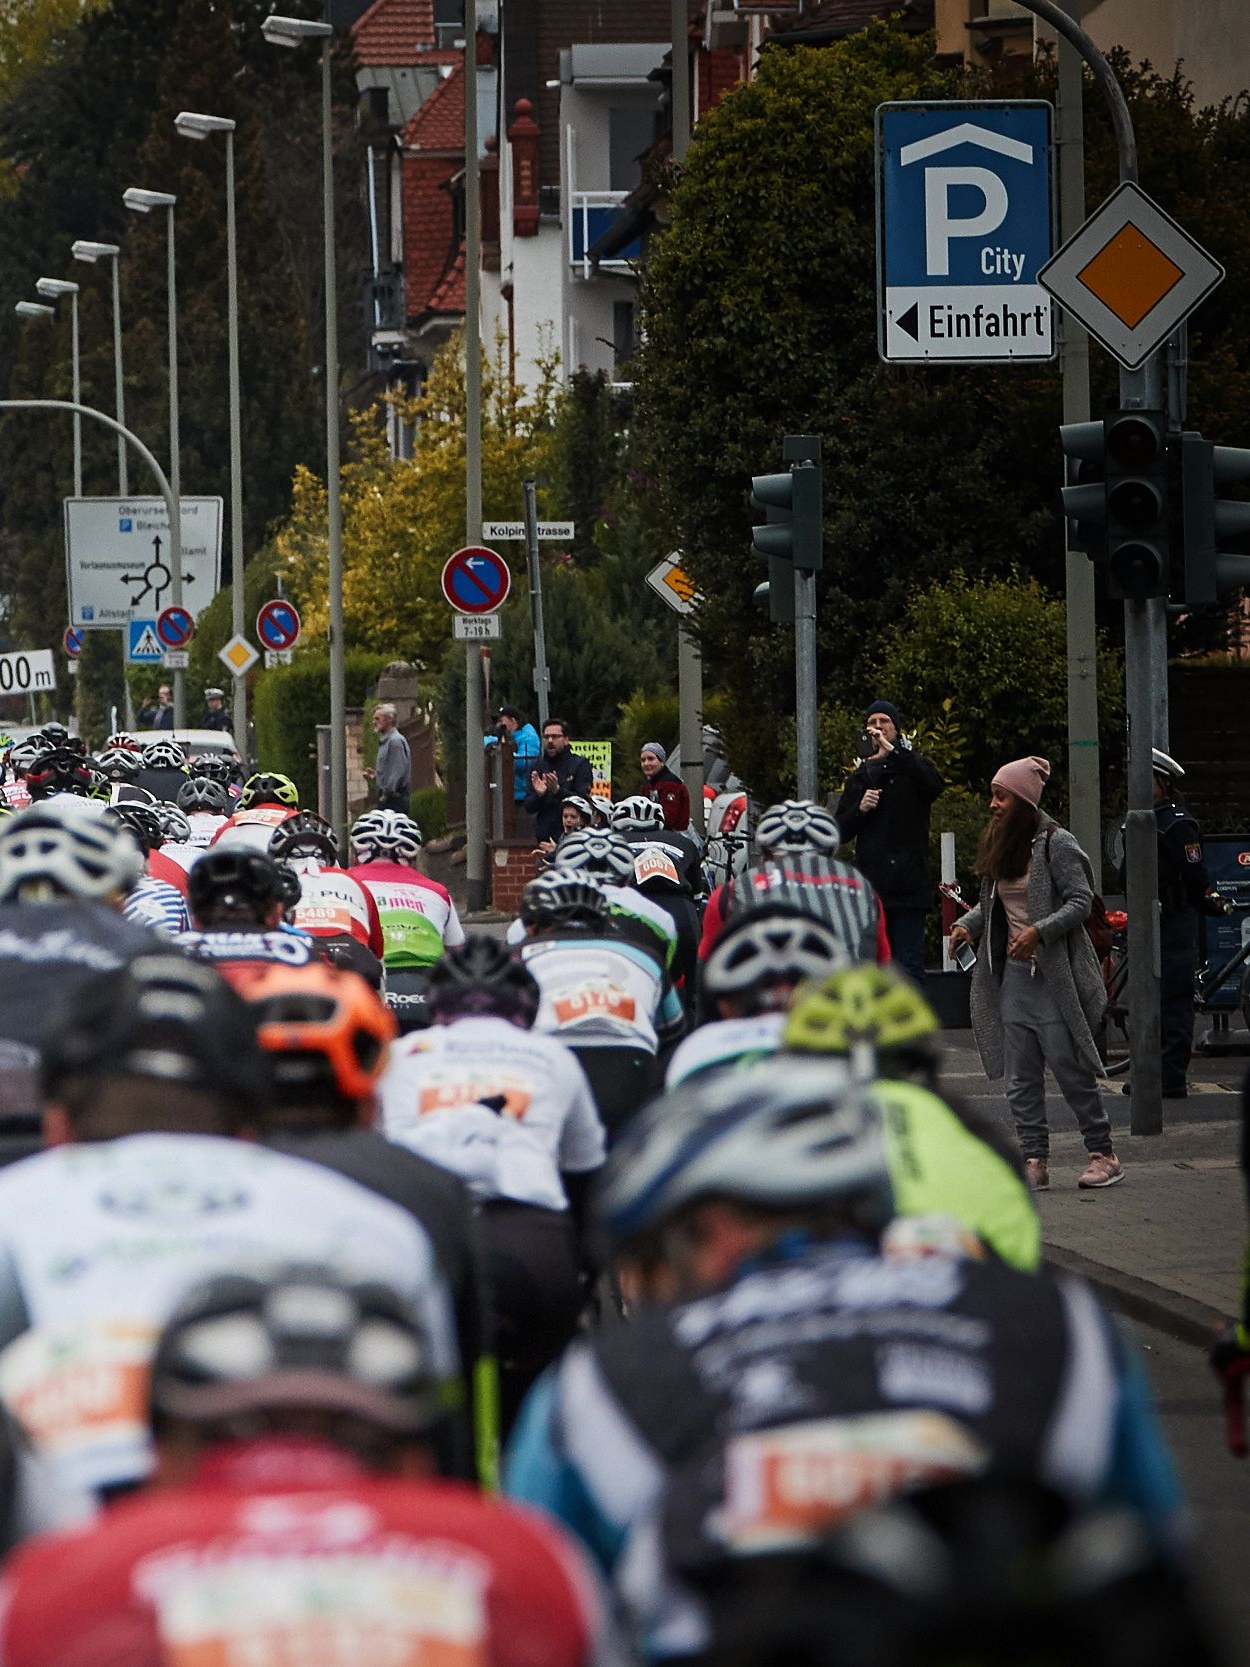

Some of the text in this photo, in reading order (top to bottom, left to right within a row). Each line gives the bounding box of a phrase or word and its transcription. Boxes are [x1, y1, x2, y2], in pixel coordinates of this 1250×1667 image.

[924, 166, 1009, 276] P
[980, 246, 1026, 281] City
[929, 304, 1044, 339] Einfahrt
[490, 526, 571, 537] Kolpintrasse
